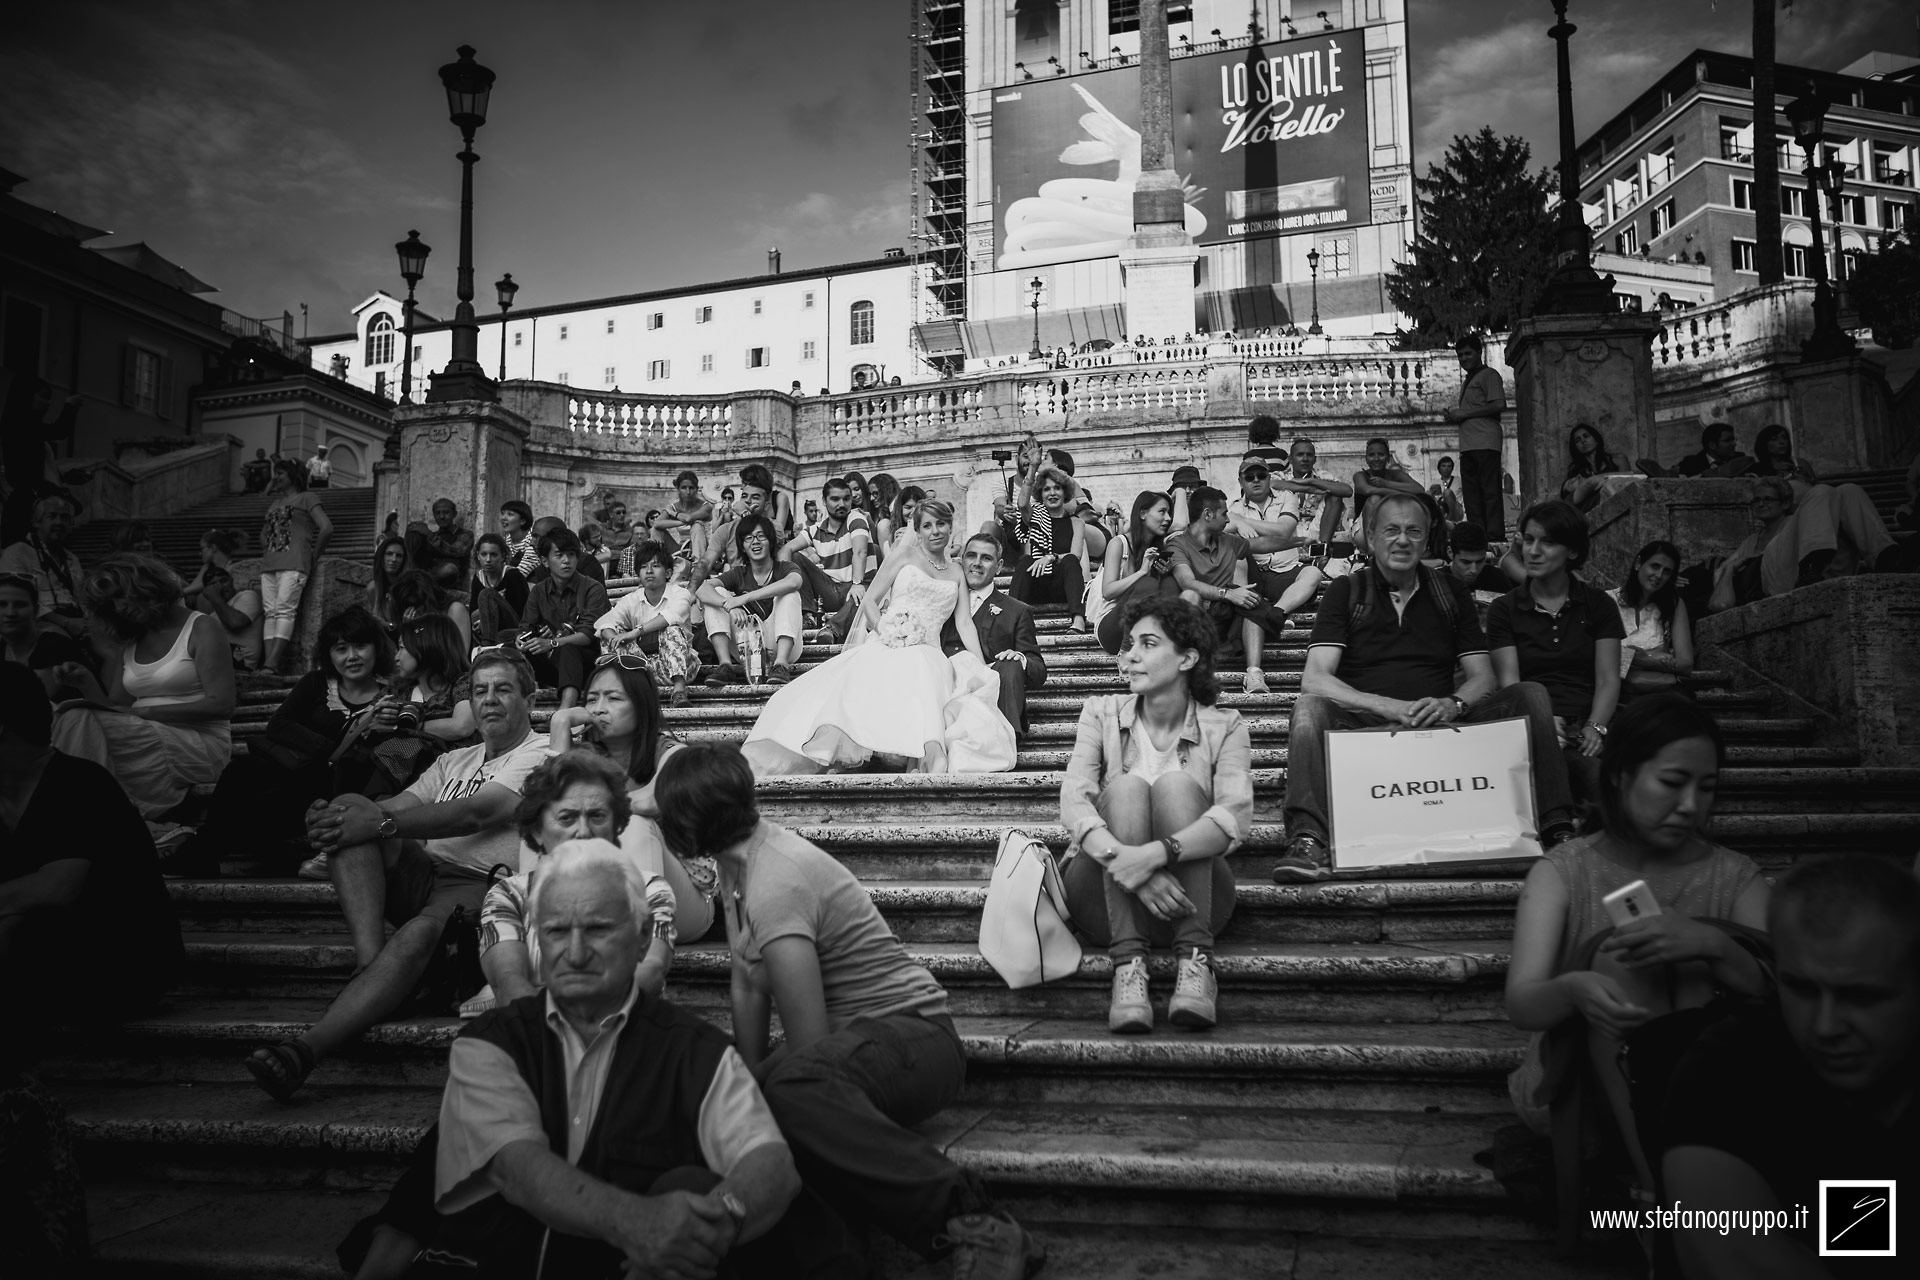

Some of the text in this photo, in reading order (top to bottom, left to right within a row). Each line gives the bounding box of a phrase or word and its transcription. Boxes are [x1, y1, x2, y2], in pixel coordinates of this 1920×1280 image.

[1221, 62, 1249, 109] LO
[1220, 98, 1345, 153] Voiello
[1227, 209, 1348, 236] L'UNICA CON GRANO AUREO 100% ITALIANO
[1371, 776, 1495, 799] CAROLI D.
